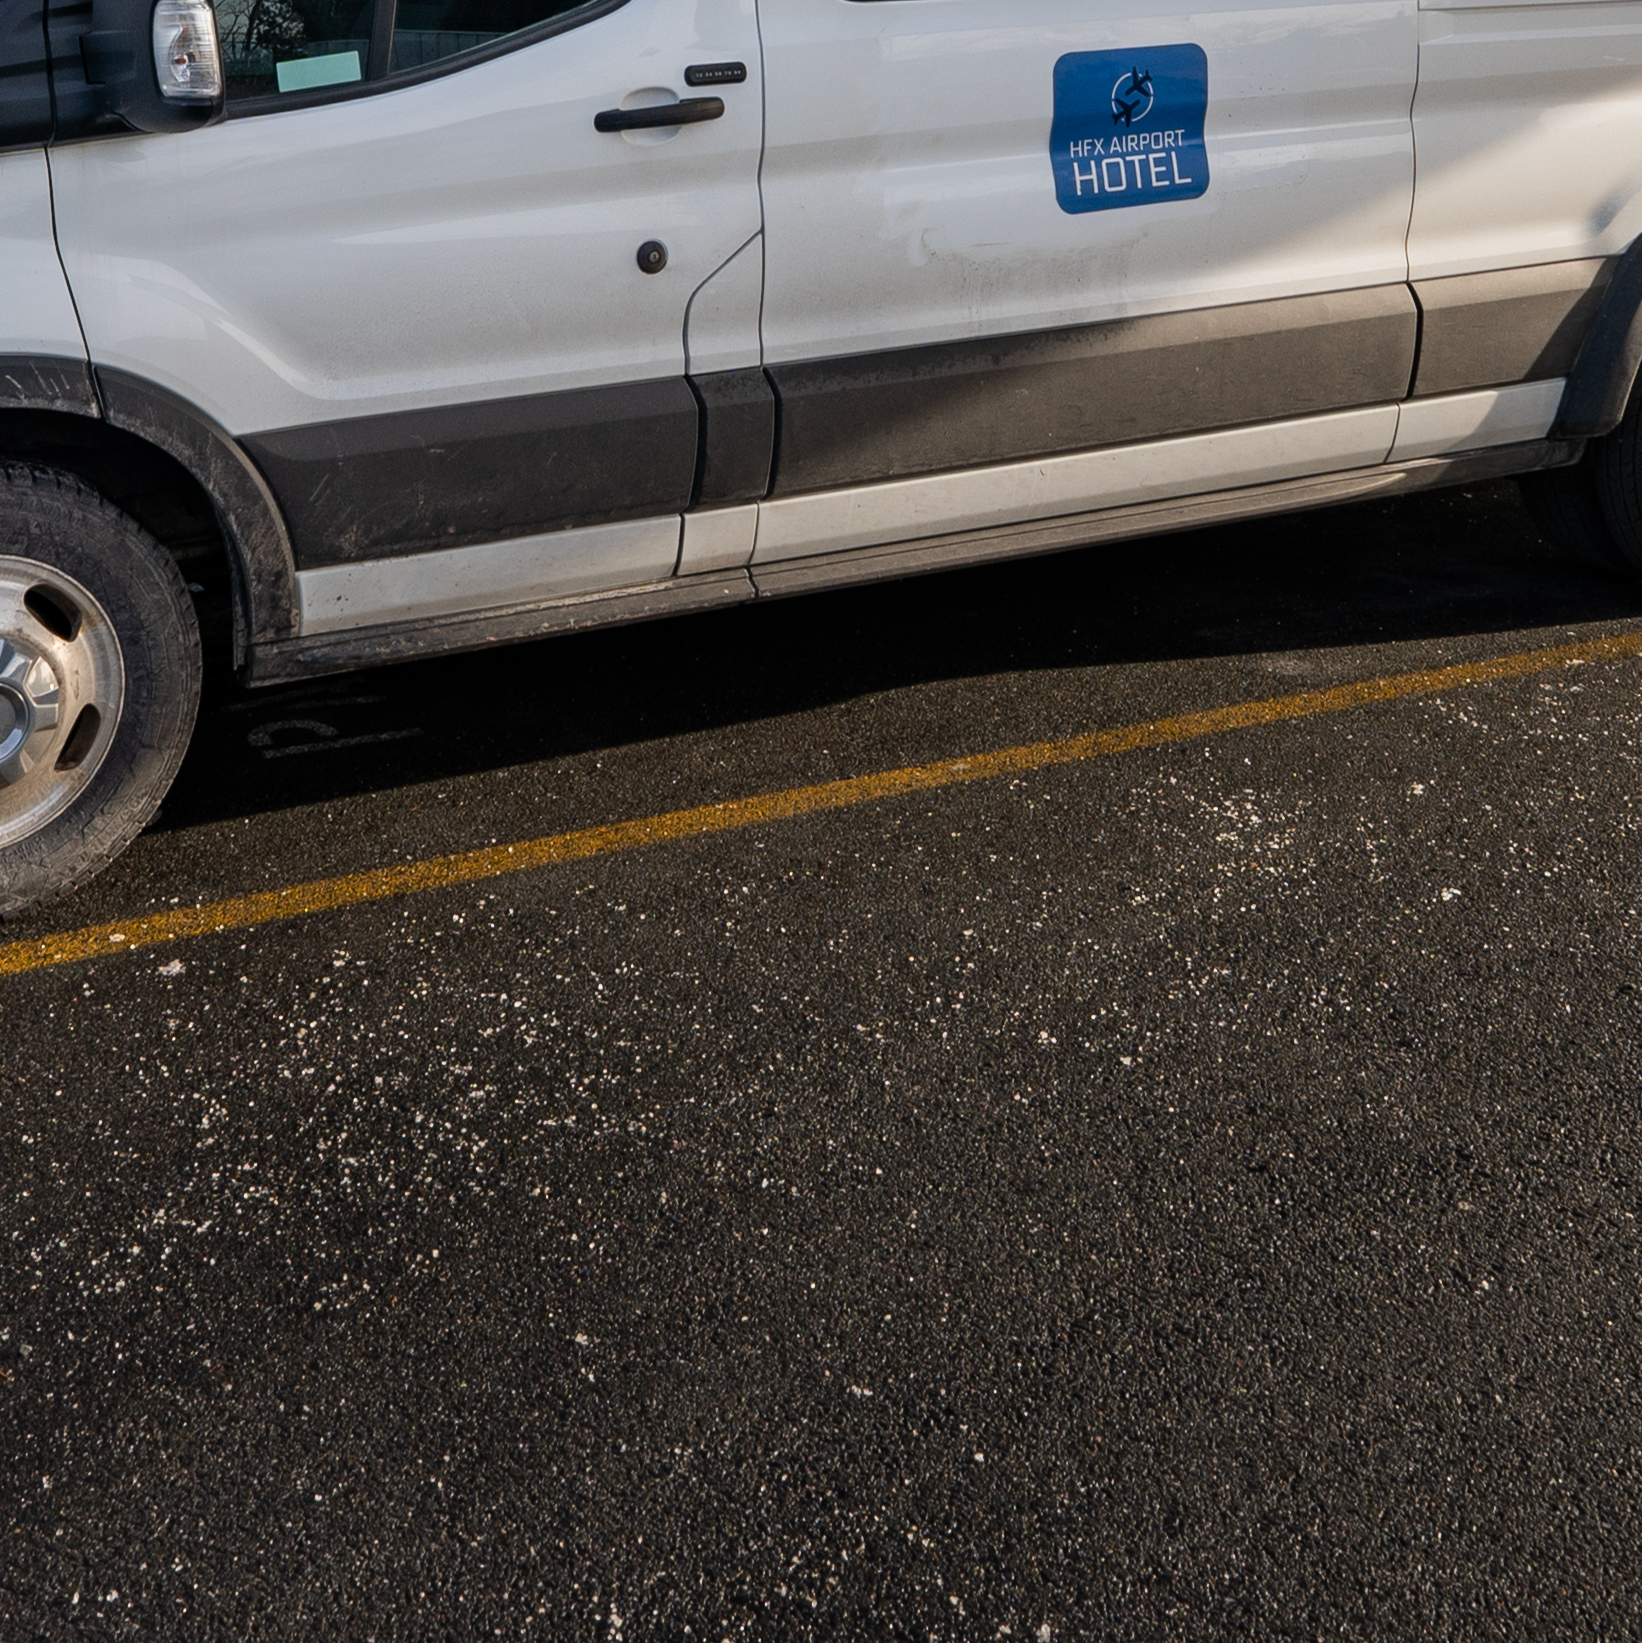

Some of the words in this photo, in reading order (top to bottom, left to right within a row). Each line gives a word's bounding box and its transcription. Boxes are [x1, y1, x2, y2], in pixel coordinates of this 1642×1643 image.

[1069, 136, 1105, 159] HFX
[1109, 129, 1186, 154] AIRPORT
[1073, 151, 1193, 197] HOTEL
